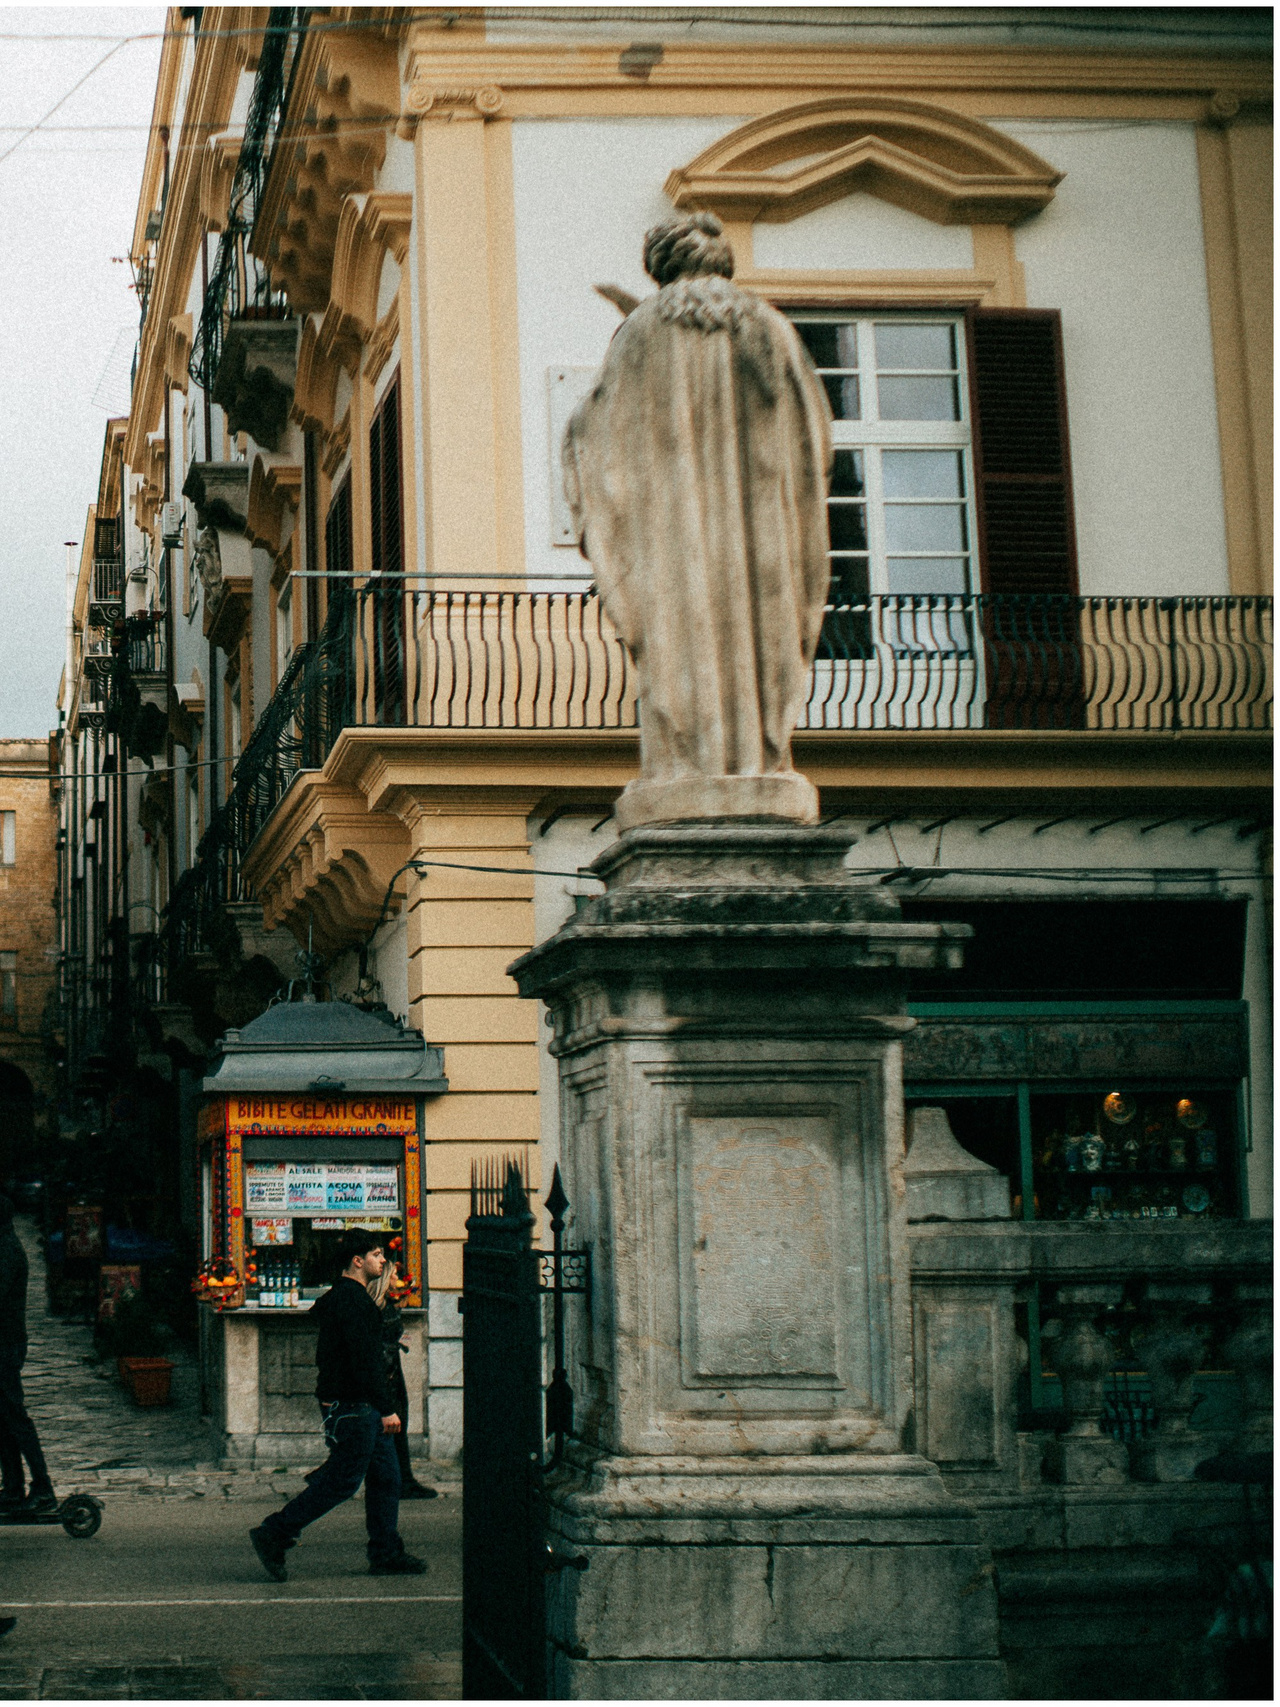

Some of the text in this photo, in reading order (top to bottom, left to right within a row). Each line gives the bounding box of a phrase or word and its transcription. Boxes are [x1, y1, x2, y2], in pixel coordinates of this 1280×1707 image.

[238, 1101, 413, 1120] BIBITE GELATI GRANITE
[327, 1182, 363, 1190] ACQUA
